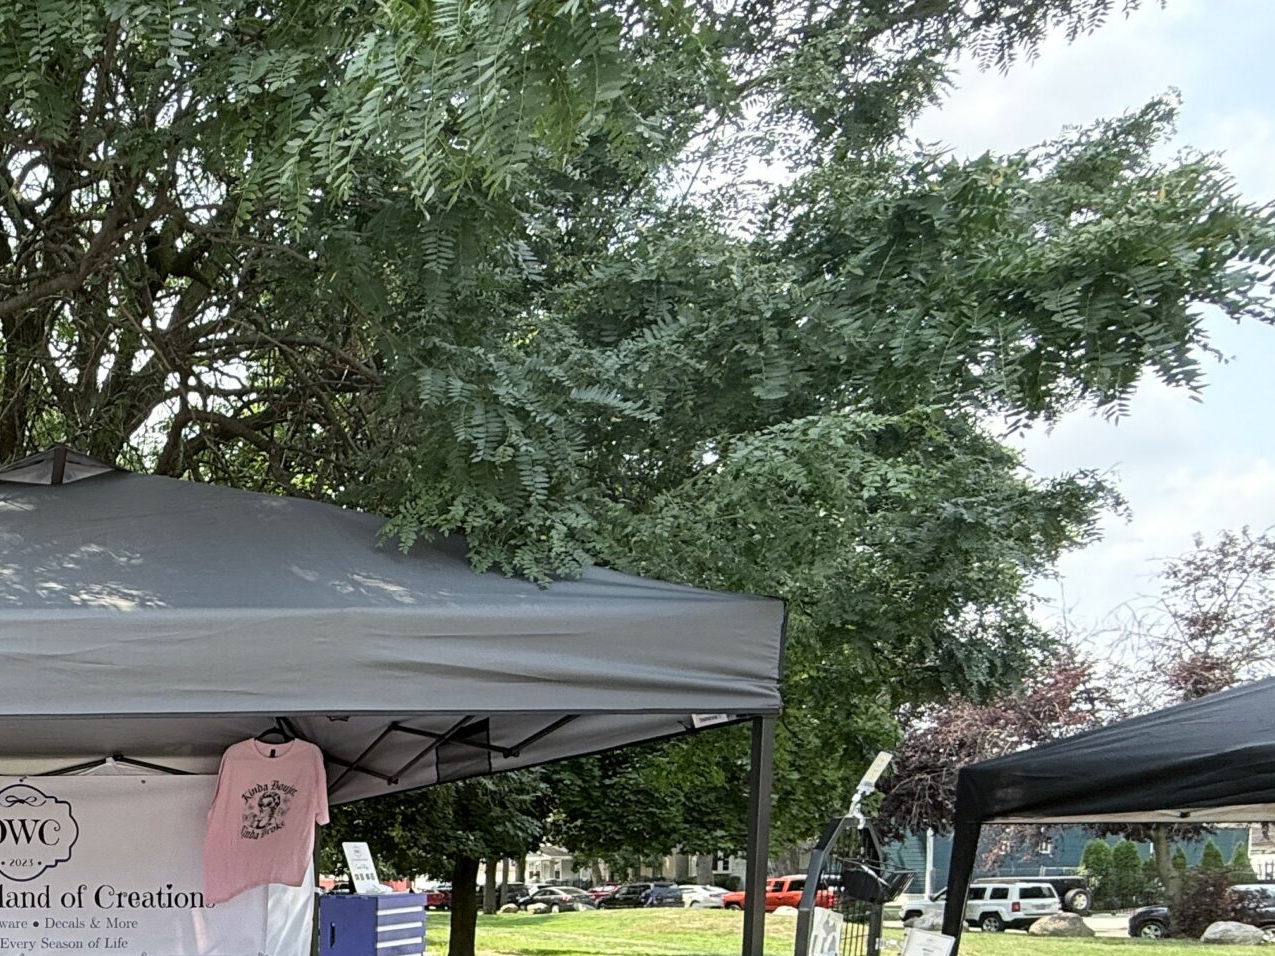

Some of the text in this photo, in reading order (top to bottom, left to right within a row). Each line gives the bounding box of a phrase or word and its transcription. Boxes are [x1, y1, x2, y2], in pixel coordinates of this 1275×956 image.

[9, 858, 34, 867] 2023
[60, 883, 88, 909] of
[44, 916, 86, 929] Decals
[89, 917, 101, 929] &
[106, 917, 139, 929] More
[0, 937, 36, 952] Every
[41, 937, 83, 949] Season
[87, 937, 102, 949] of
[105, 937, 128, 949] Life
